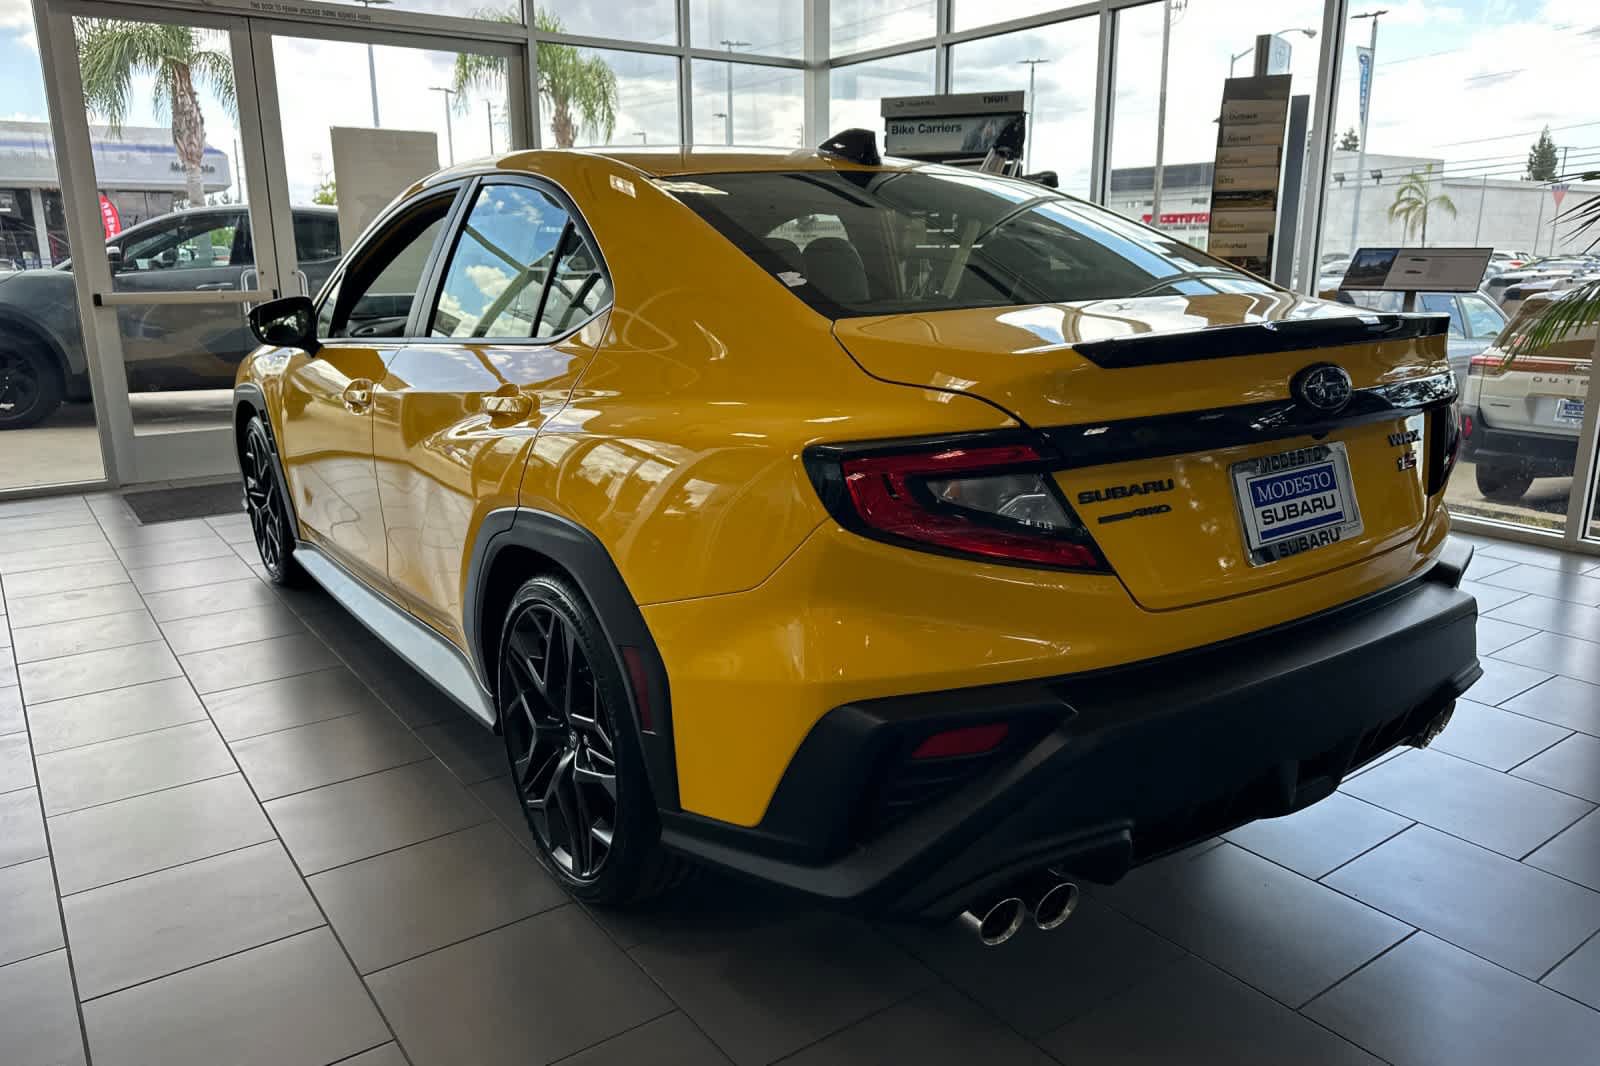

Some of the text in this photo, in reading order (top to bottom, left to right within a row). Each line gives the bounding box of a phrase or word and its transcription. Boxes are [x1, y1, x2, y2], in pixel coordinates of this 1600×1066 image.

[891, 122, 962, 136] Bike Carriers
[1532, 376, 1590, 386] OUTB
[1388, 429, 1421, 447] WRX
[1258, 446, 1324, 473] MODESTO
[1078, 478, 1175, 504] SUBARU
[1256, 471, 1332, 503] MODESTO
[1261, 494, 1337, 526] SUBARU
[1278, 526, 1341, 557] SUBARU
